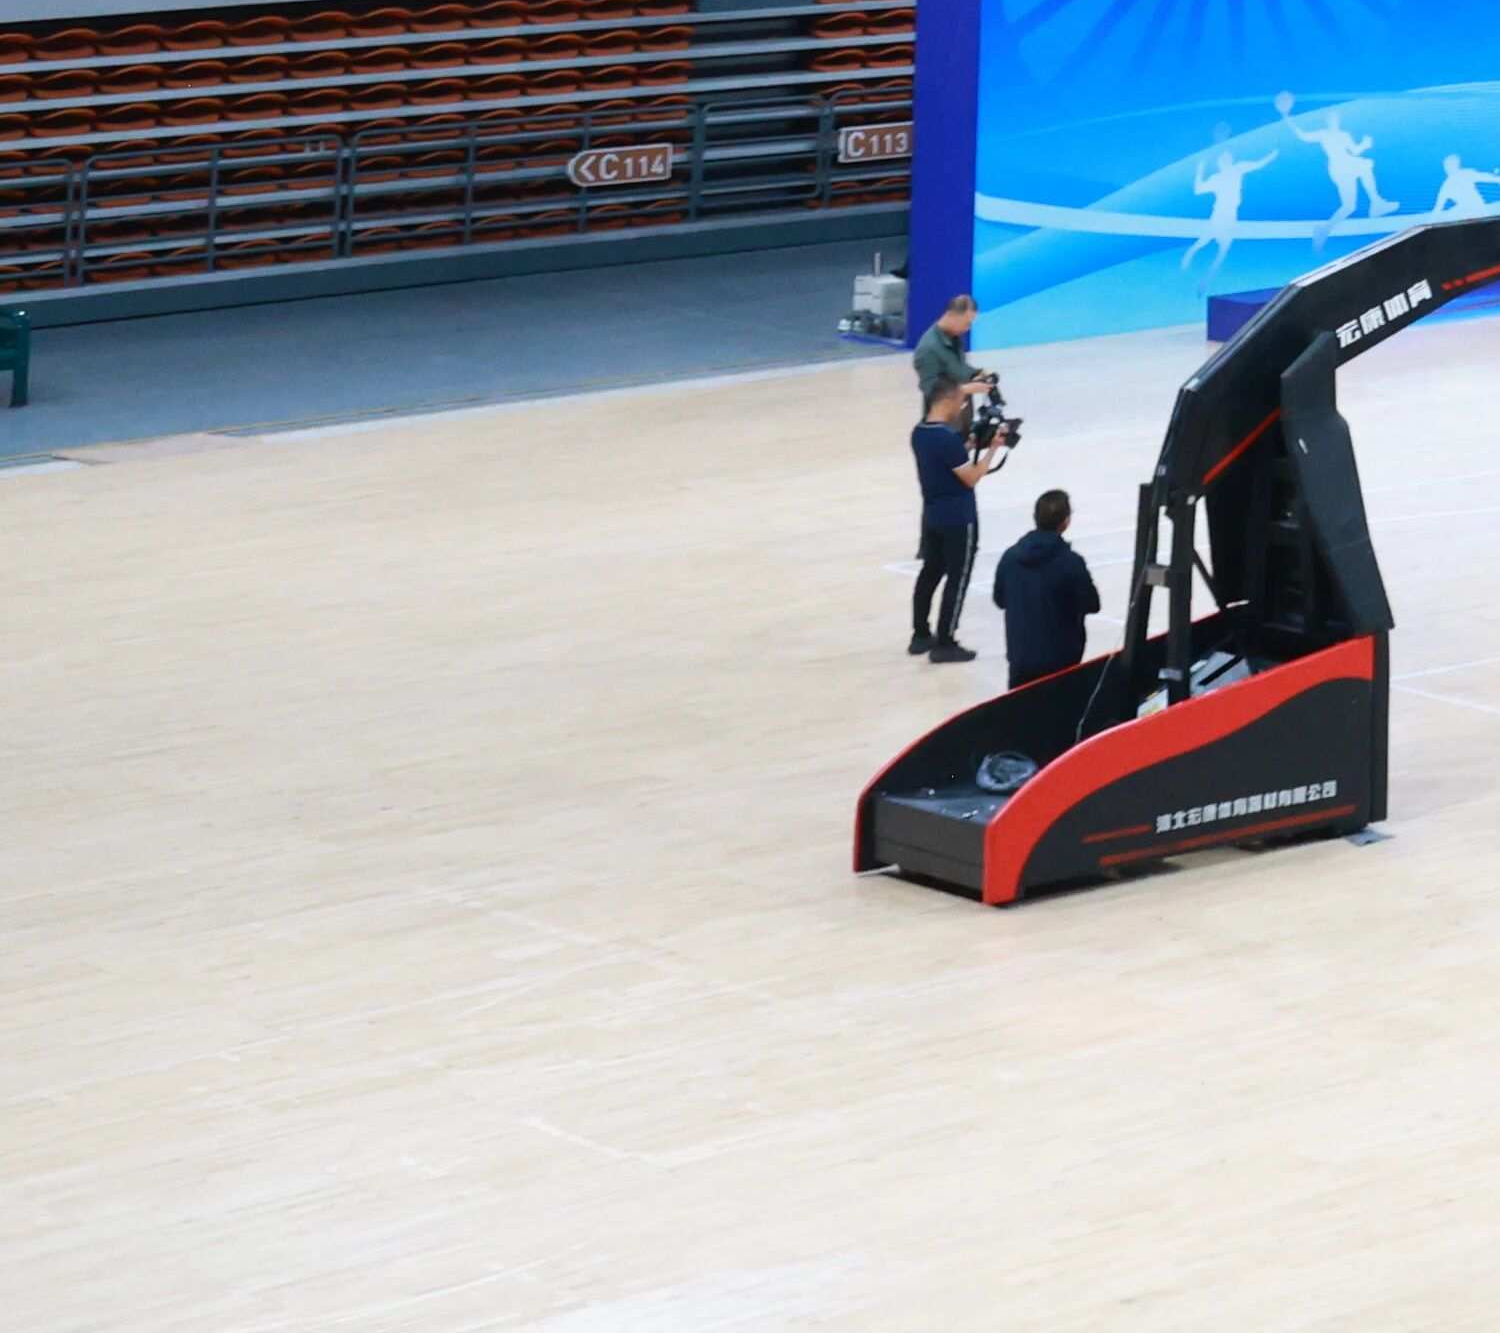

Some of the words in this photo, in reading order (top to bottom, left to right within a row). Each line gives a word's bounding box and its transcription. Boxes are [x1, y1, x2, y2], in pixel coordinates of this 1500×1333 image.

[846, 126, 909, 160] C113
[599, 150, 665, 182] C114
[1335, 278, 1433, 349] 宏康体育
